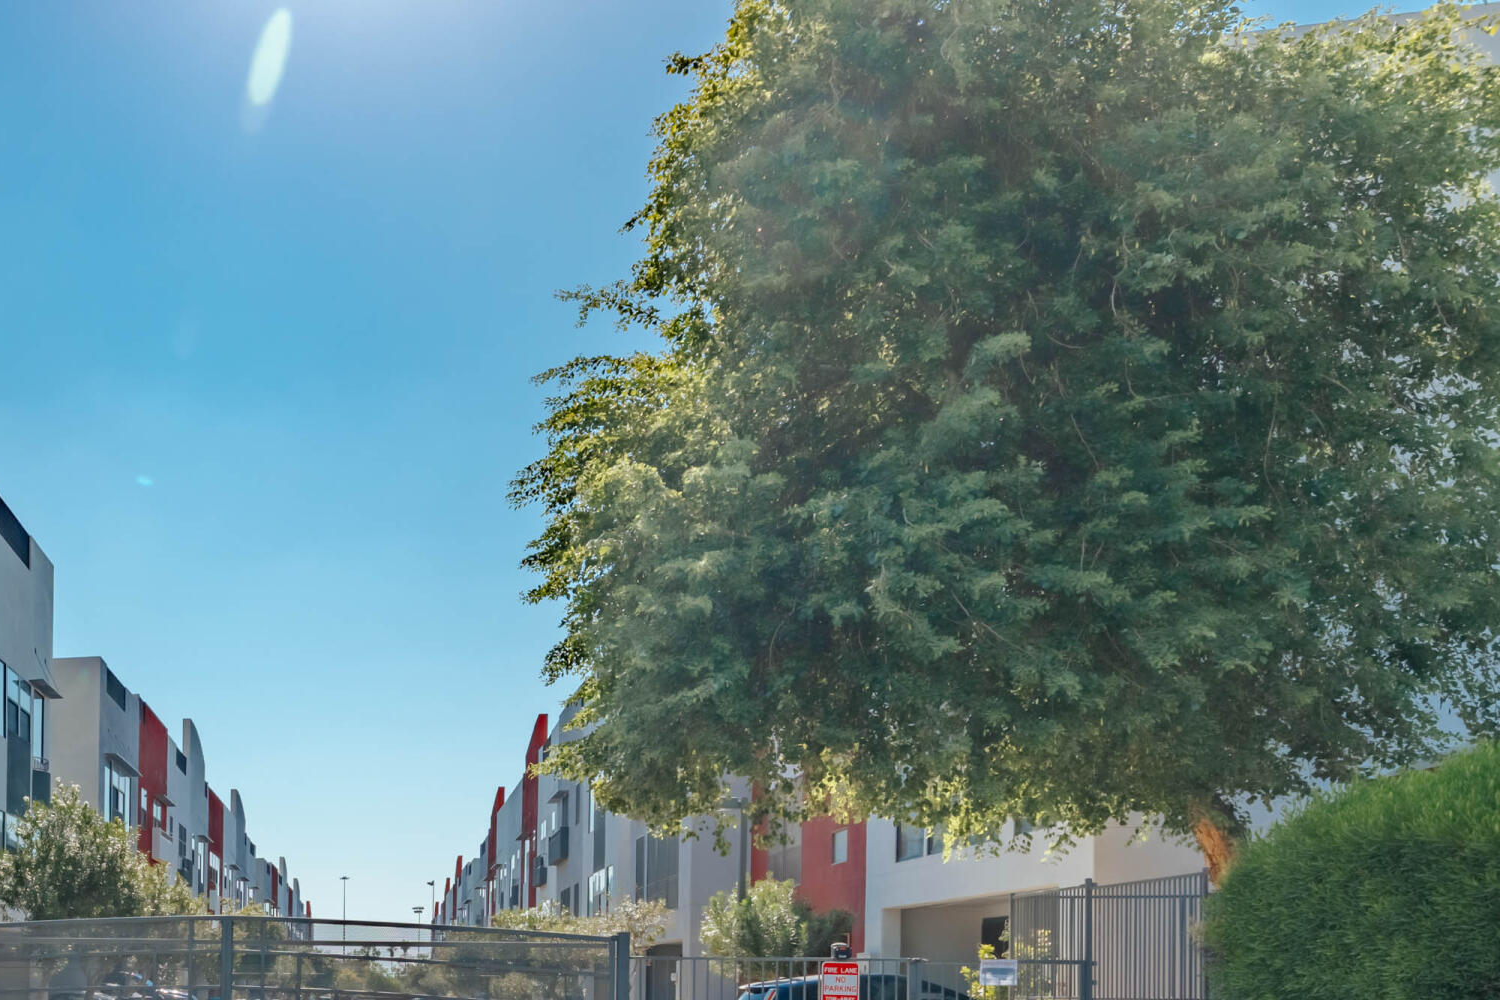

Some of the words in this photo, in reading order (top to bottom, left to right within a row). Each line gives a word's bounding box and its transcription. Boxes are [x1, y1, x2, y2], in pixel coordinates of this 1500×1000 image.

[824, 966, 838, 974] FIRE
[840, 967, 858, 975] LANE
[824, 985, 857, 993] PARKING
